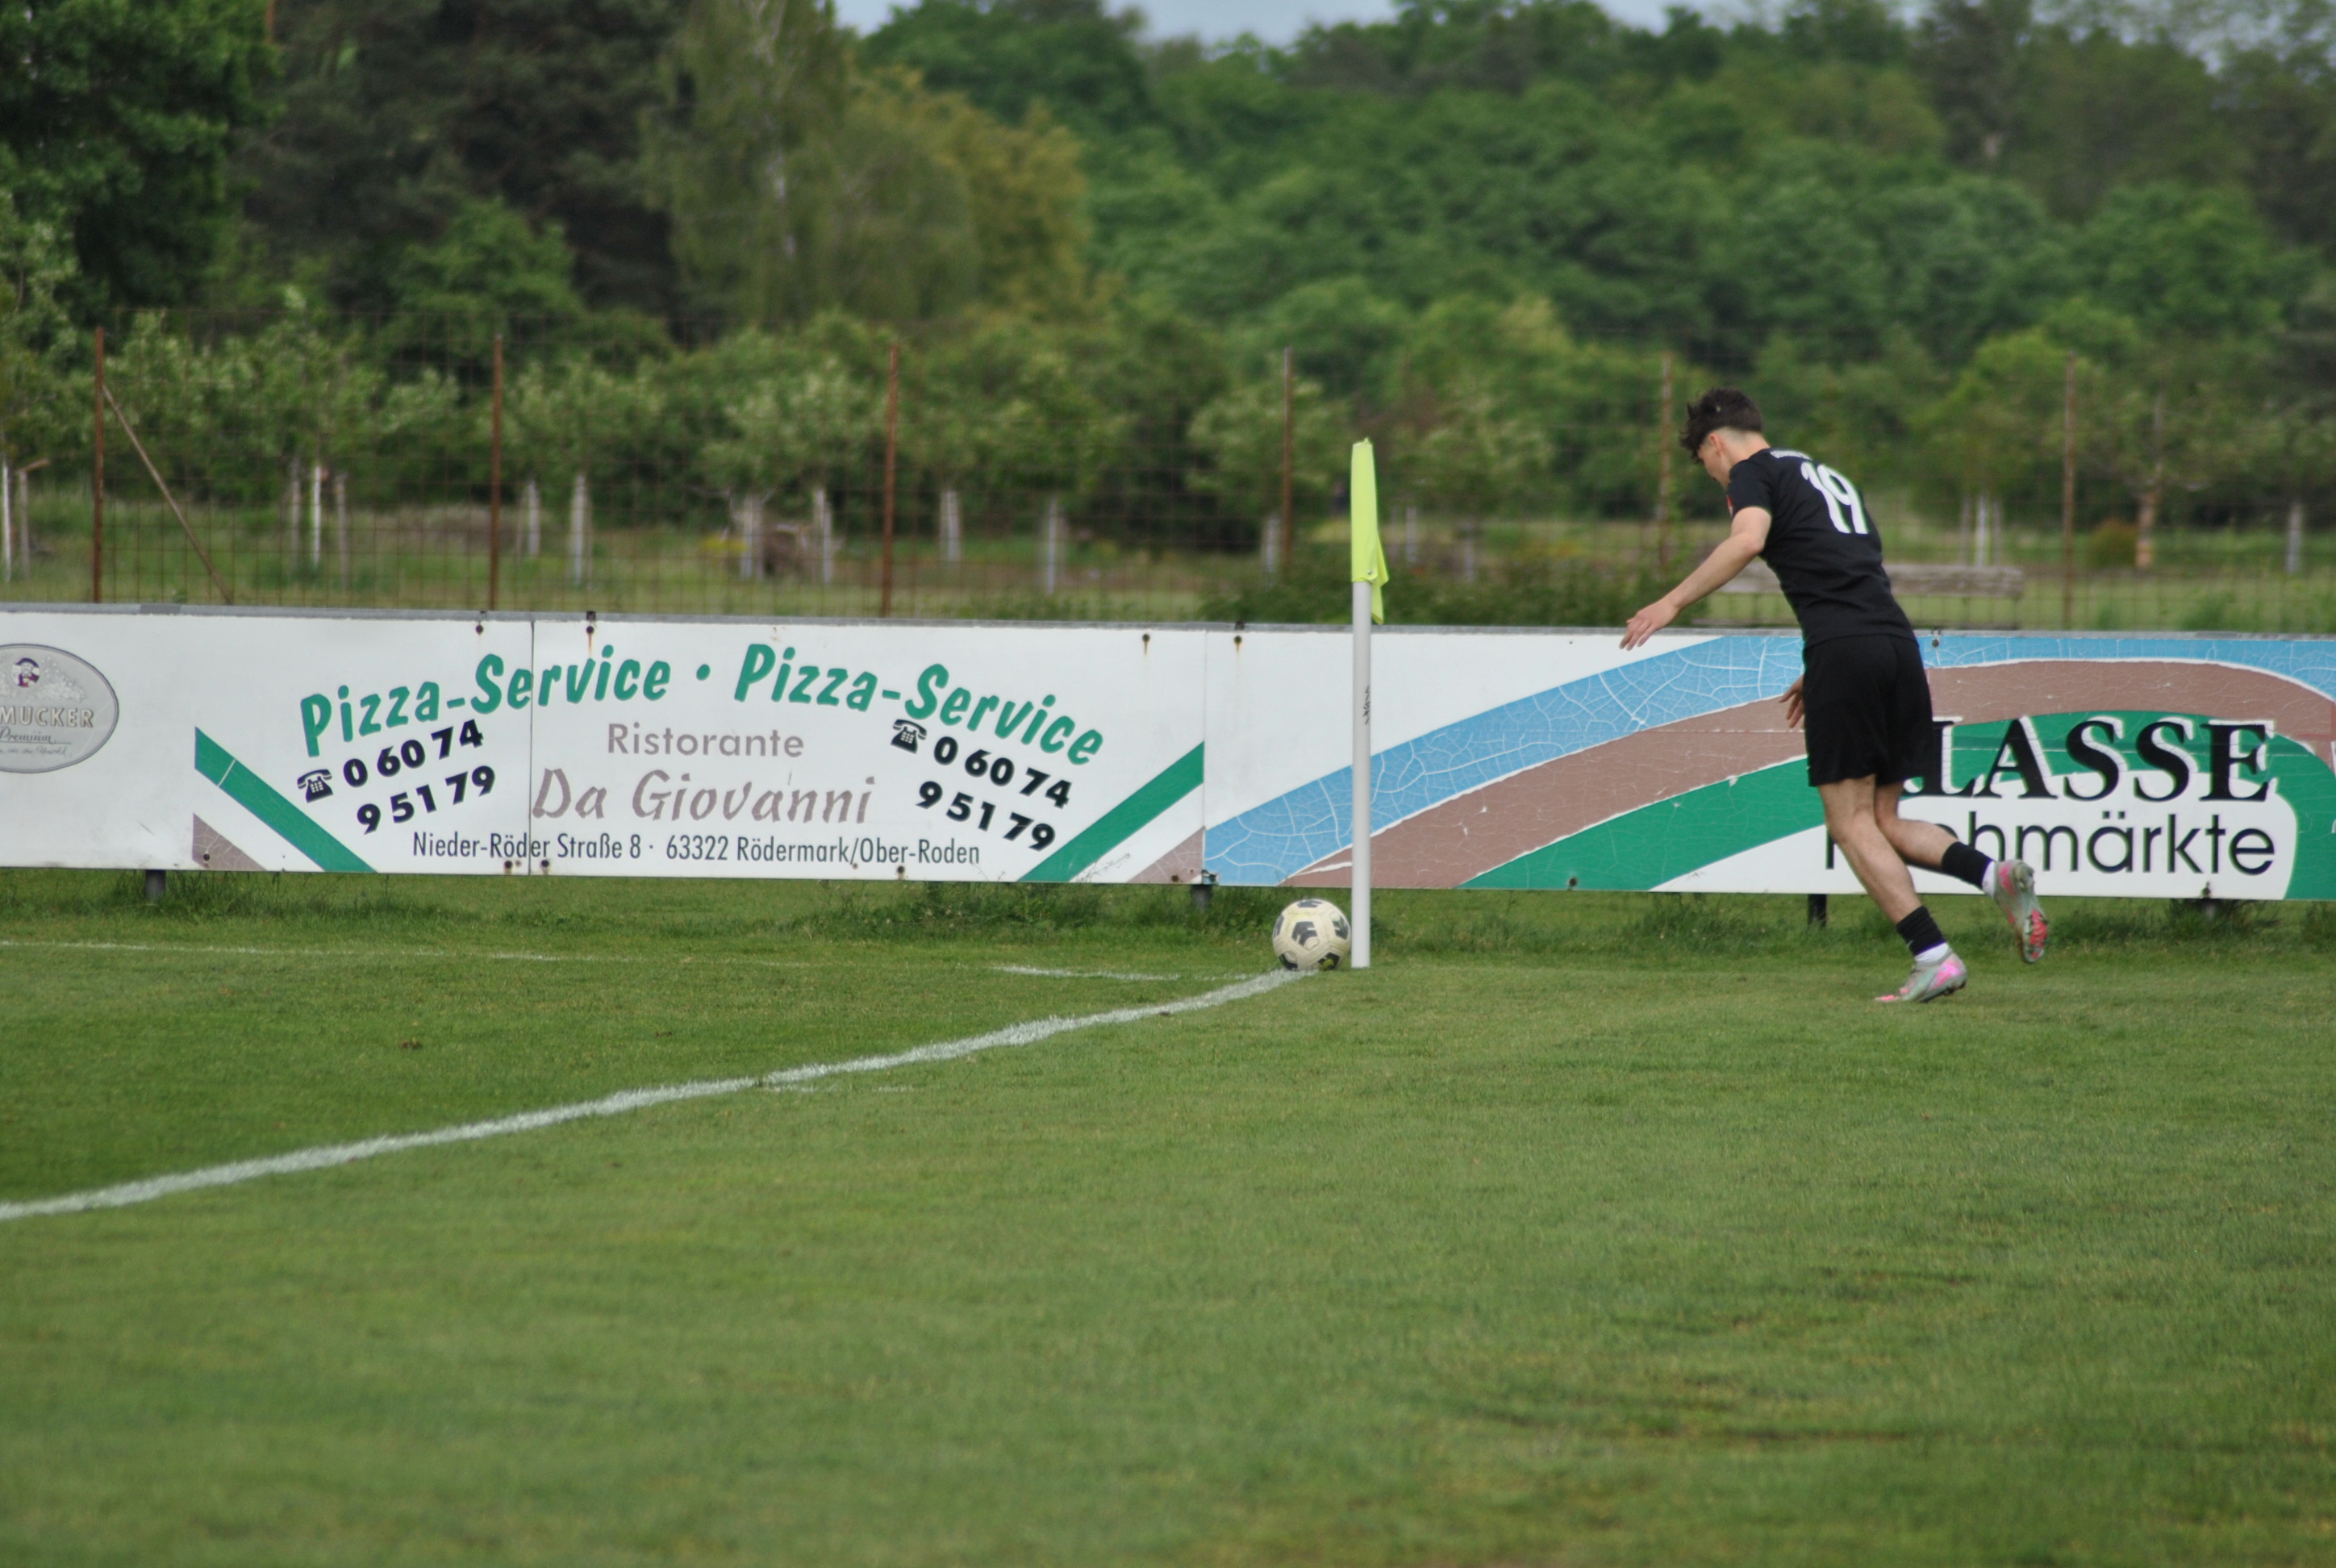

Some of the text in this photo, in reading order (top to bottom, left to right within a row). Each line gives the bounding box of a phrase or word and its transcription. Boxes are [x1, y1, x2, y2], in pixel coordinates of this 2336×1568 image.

[1800, 461, 1869, 534] 19
[299, 643, 1103, 765] Pizza-Service Pizza-Service
[607, 722, 805, 757] Ristorante
[1900, 715, 2277, 802] LASSE
[532, 768, 876, 824] Da Giovanni
[413, 831, 979, 865] Nieder-Röder Straße 8 63322 Rödermark/Ober-Roden
